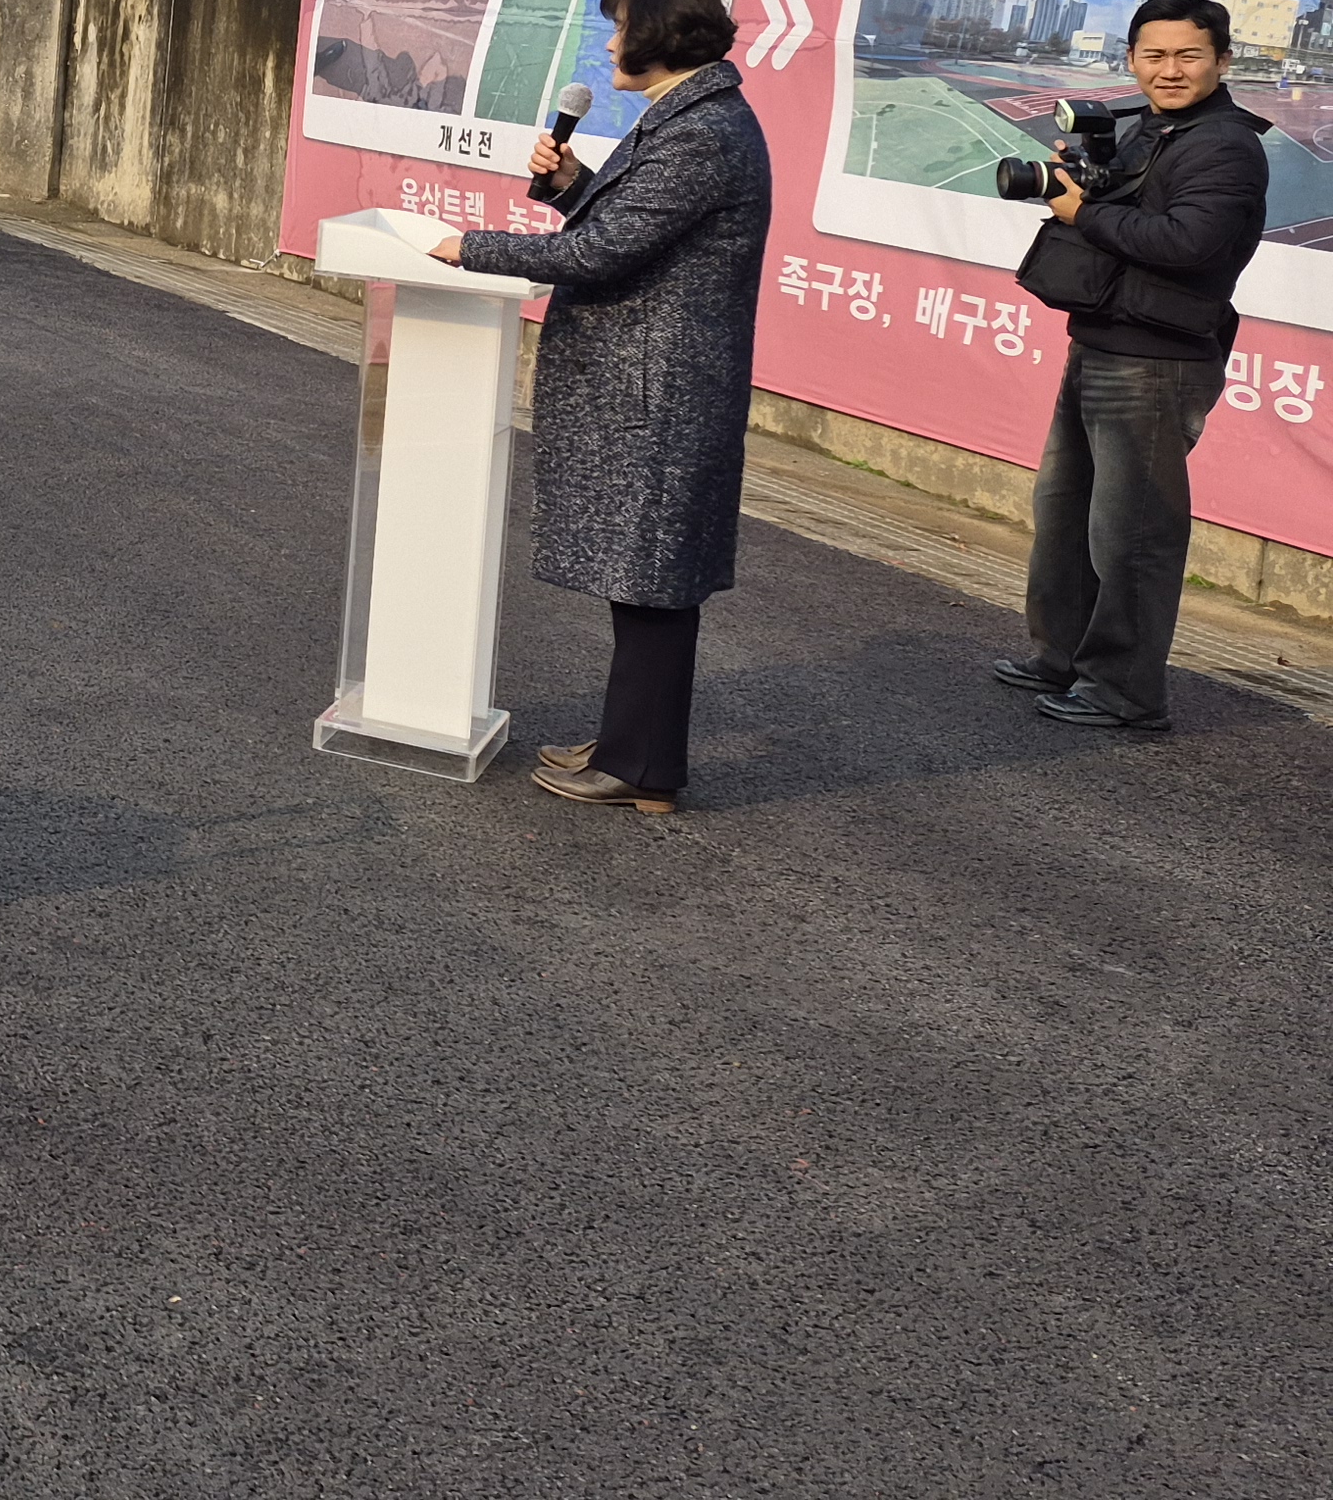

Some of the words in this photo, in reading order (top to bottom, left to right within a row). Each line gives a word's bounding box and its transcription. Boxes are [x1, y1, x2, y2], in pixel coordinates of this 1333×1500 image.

[506, 198, 566, 235] 농구
[777, 254, 893, 329] 족구장,
[914, 285, 1044, 365] 배구장,
[1224, 350, 1325, 424] 밍장
